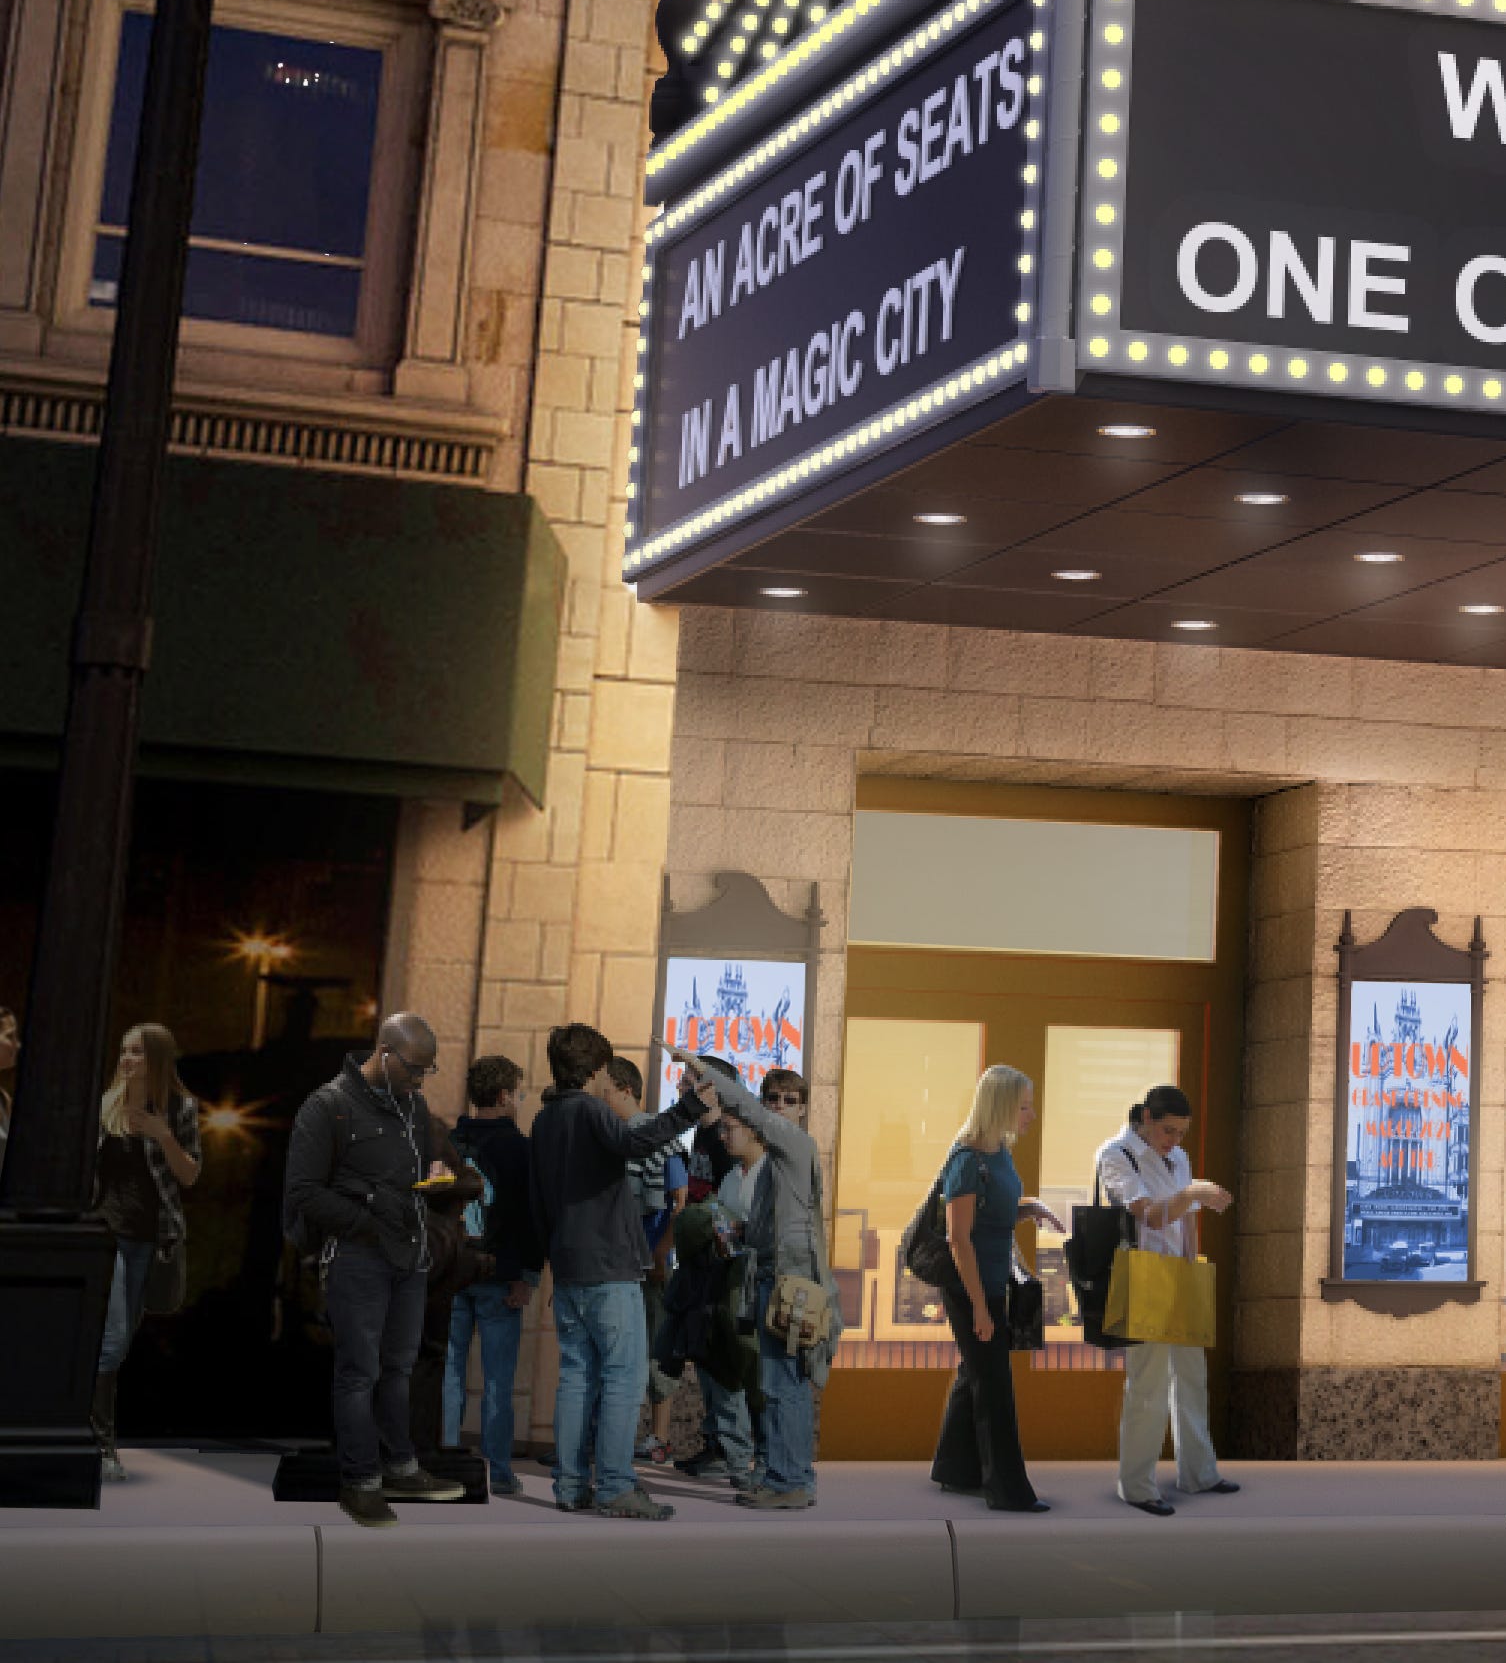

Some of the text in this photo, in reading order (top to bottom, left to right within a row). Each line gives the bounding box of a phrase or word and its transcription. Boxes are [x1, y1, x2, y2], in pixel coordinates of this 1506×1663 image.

[678, 37, 1026, 339] AN ACRE OF SEATS
[1176, 220, 1410, 334] ONE
[678, 247, 966, 490] IN A MAGIC CITY
[666, 1016, 803, 1053] UPTOWN
[1350, 1042, 1469, 1079] UPTOWN
